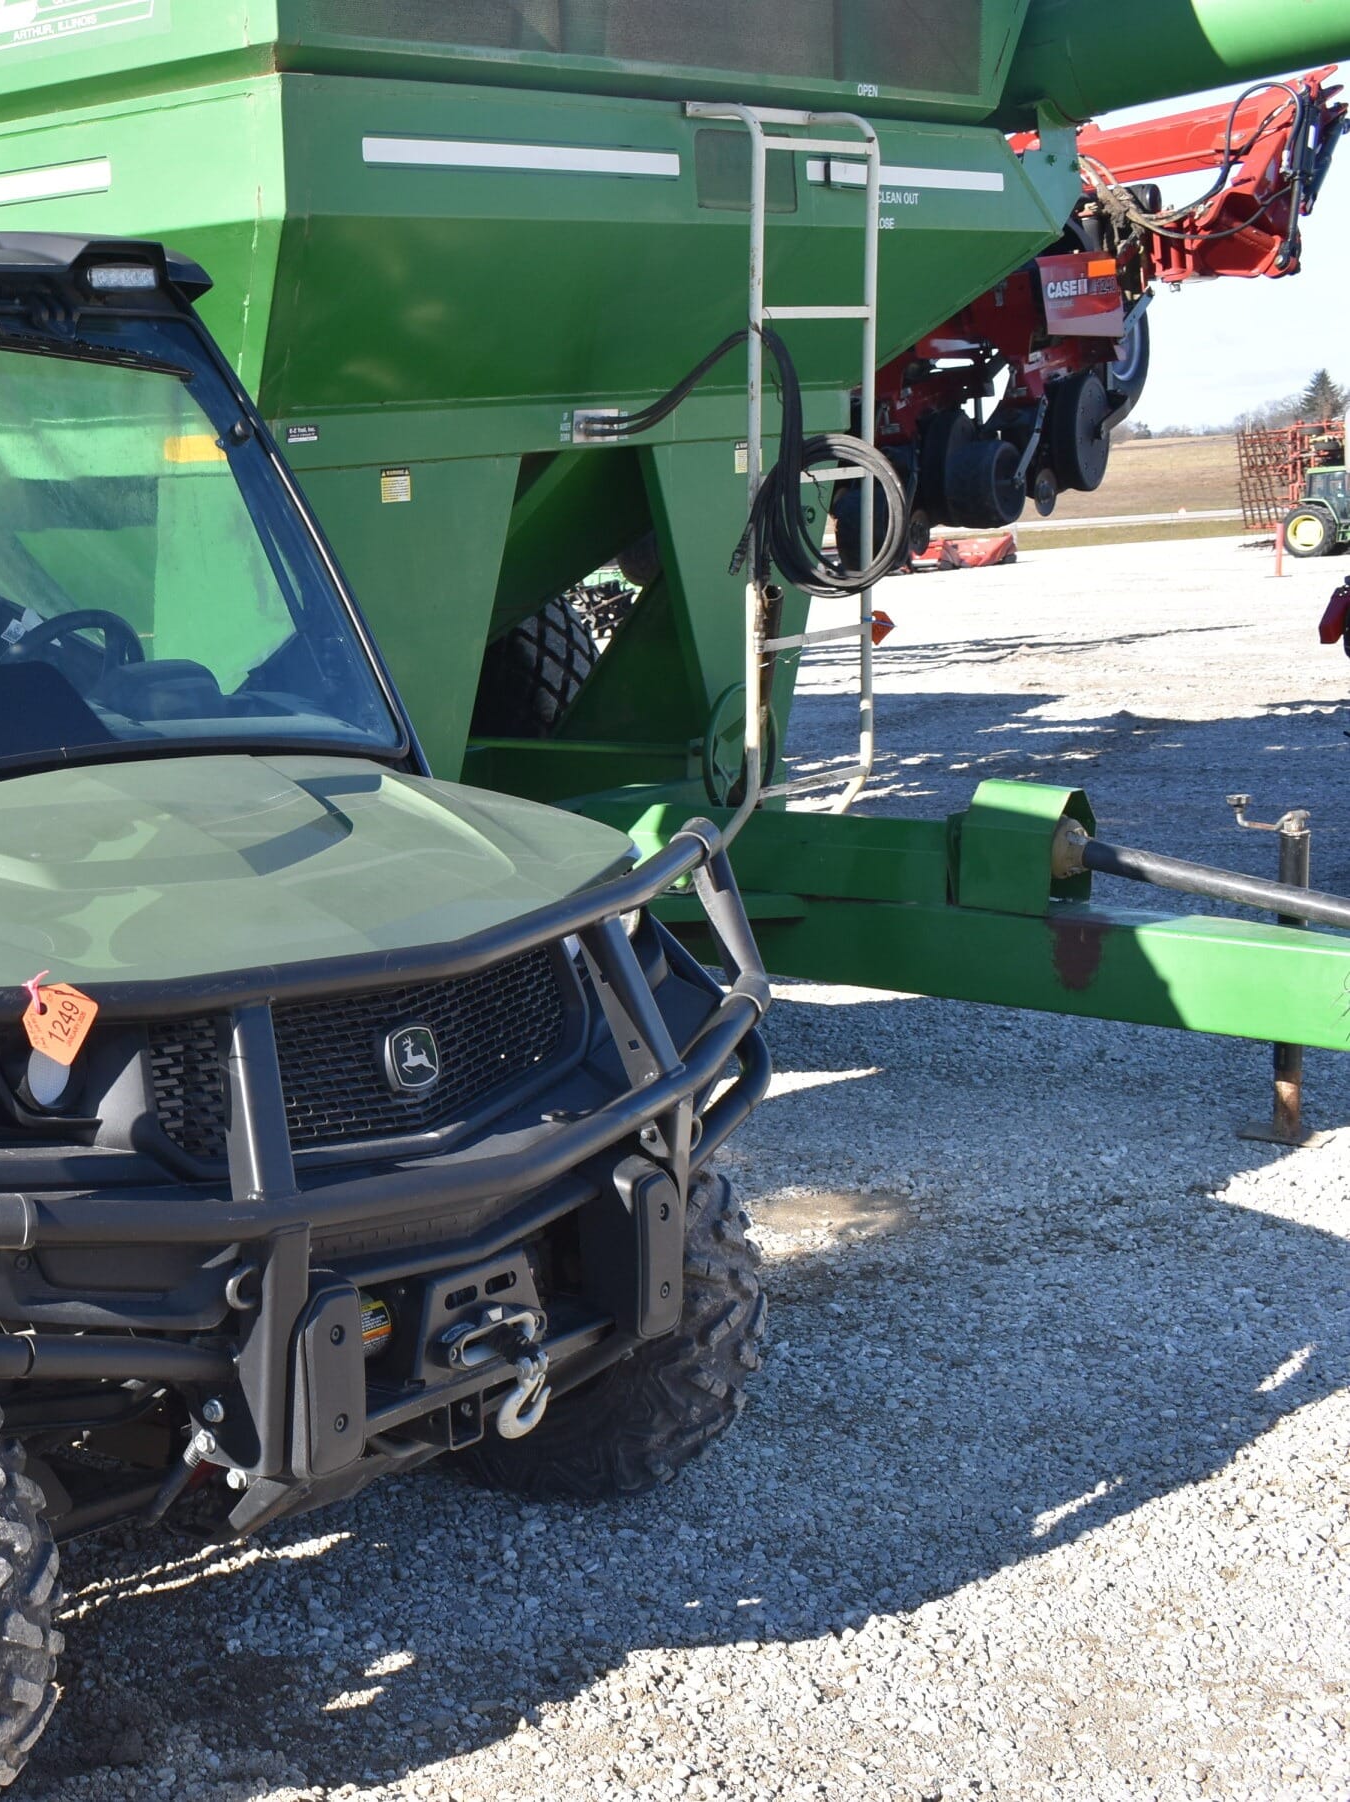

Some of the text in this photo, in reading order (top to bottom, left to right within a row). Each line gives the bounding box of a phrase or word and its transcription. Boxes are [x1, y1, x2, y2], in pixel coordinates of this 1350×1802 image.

[58, 14, 98, 32] ILLINOIS
[857, 83, 879, 97] OPEN
[903, 192, 920, 205] OUT
[1046, 280, 1077, 299] CASE
[48, 1000, 80, 1043] 1249
